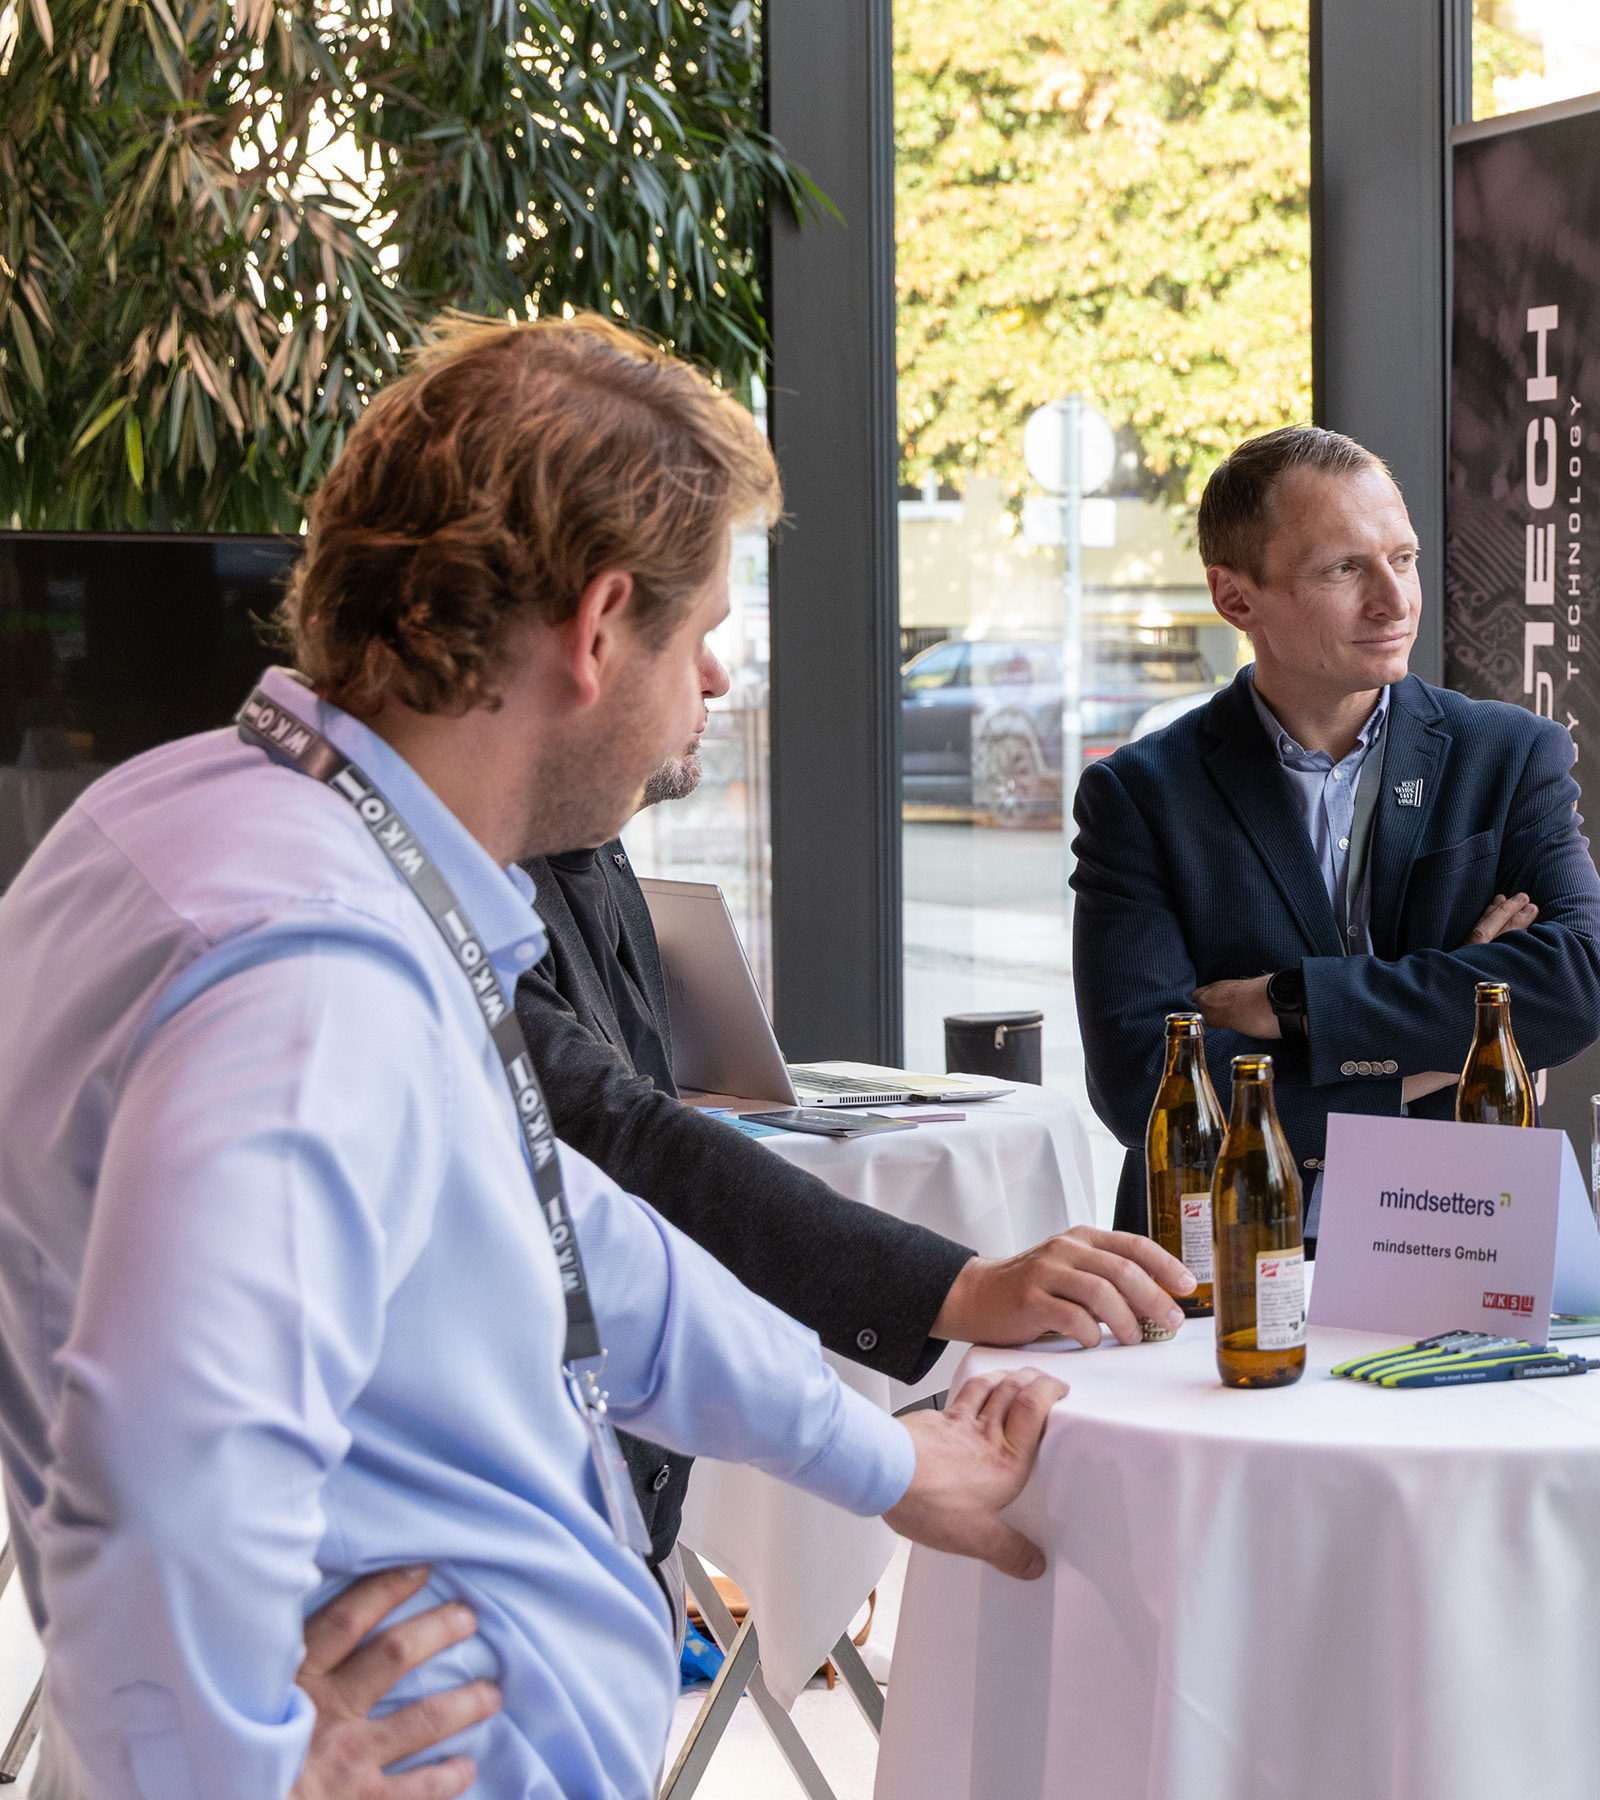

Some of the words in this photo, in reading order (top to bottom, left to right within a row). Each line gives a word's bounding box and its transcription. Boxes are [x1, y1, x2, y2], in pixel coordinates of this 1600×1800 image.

[1523, 304, 1558, 720] TECH
[1566, 395, 1582, 681] TECHNOLOGY
[1379, 1187, 1496, 1217] mindsetters
[1372, 1239, 1452, 1258] mindsetters
[1454, 1245, 1498, 1263] GmbH
[1523, 1363, 1569, 1376] mindsetters
